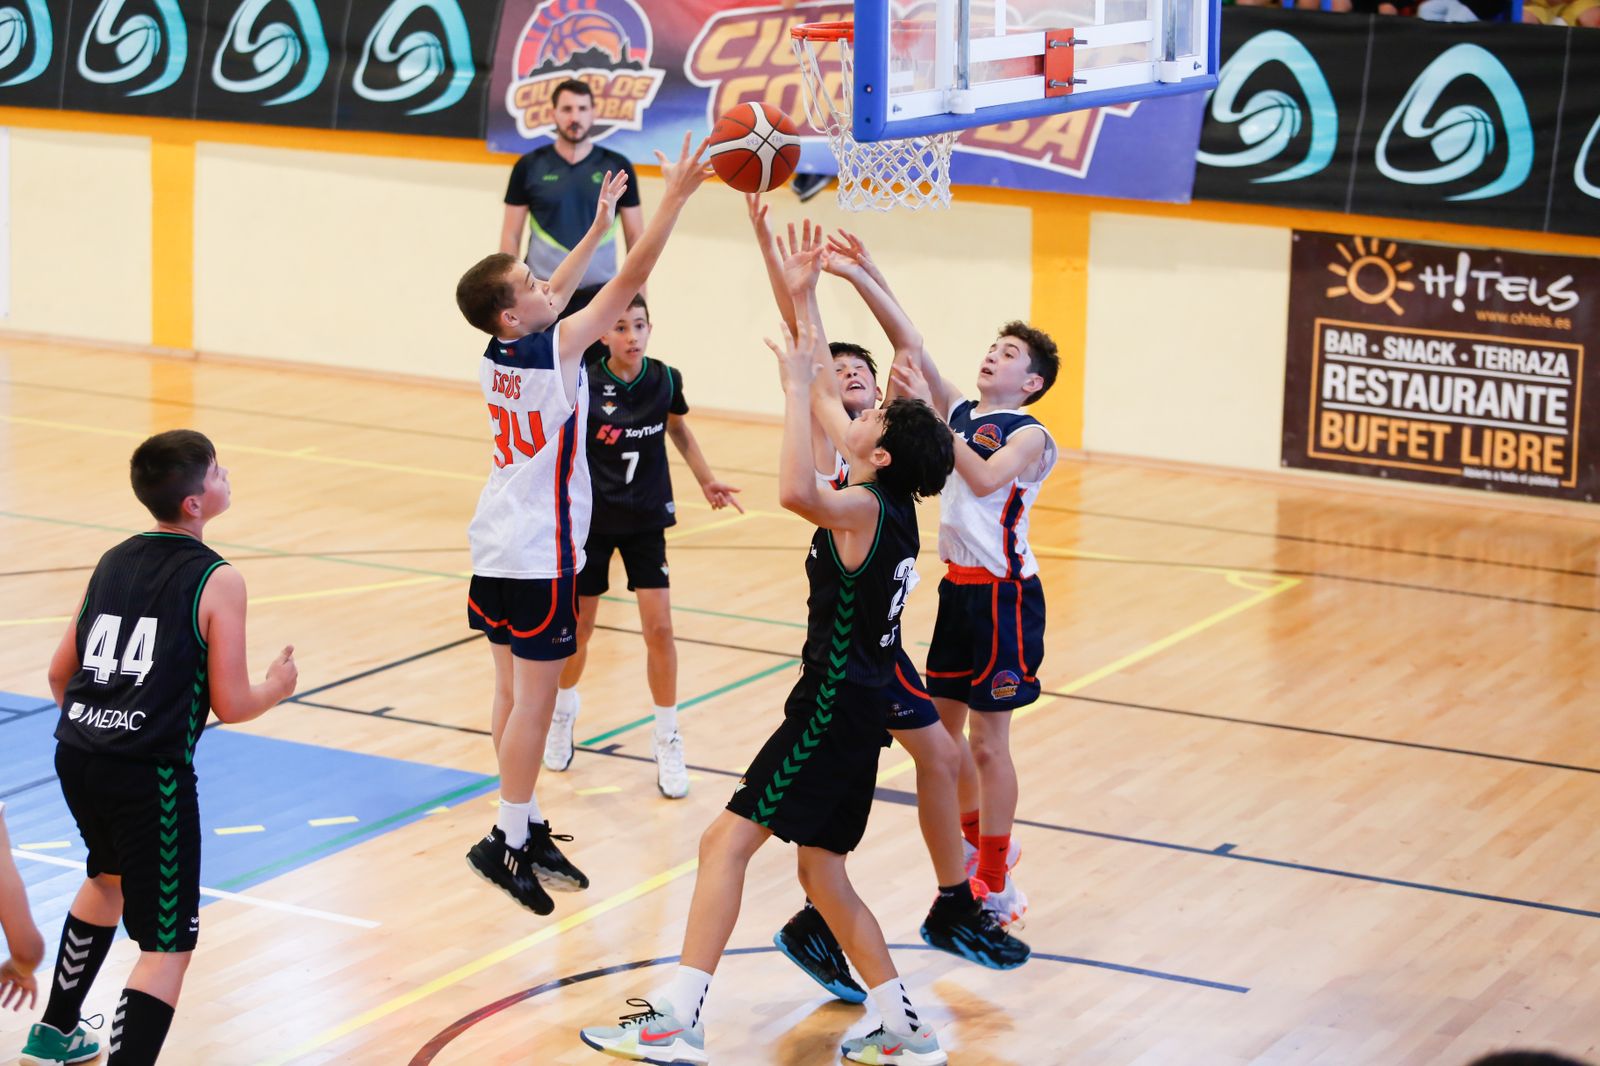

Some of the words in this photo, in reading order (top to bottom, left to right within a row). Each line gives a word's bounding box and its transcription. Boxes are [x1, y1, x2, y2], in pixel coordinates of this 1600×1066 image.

[610, 74, 656, 99] DE
[1475, 310, 1572, 330] www.ohtels.es
[1324, 329, 1367, 357] BAR
[1383, 335, 1456, 366] SNACK
[1473, 344, 1570, 378] TERRAZA
[1322, 362, 1568, 426] RESTAURANTE
[487, 402, 547, 470] 34
[1320, 410, 1451, 462] BUFFET
[1461, 426, 1565, 475] LIBRE
[621, 451, 640, 485] 7
[82, 613, 158, 686] 44
[79, 706, 146, 731] MEDAC
